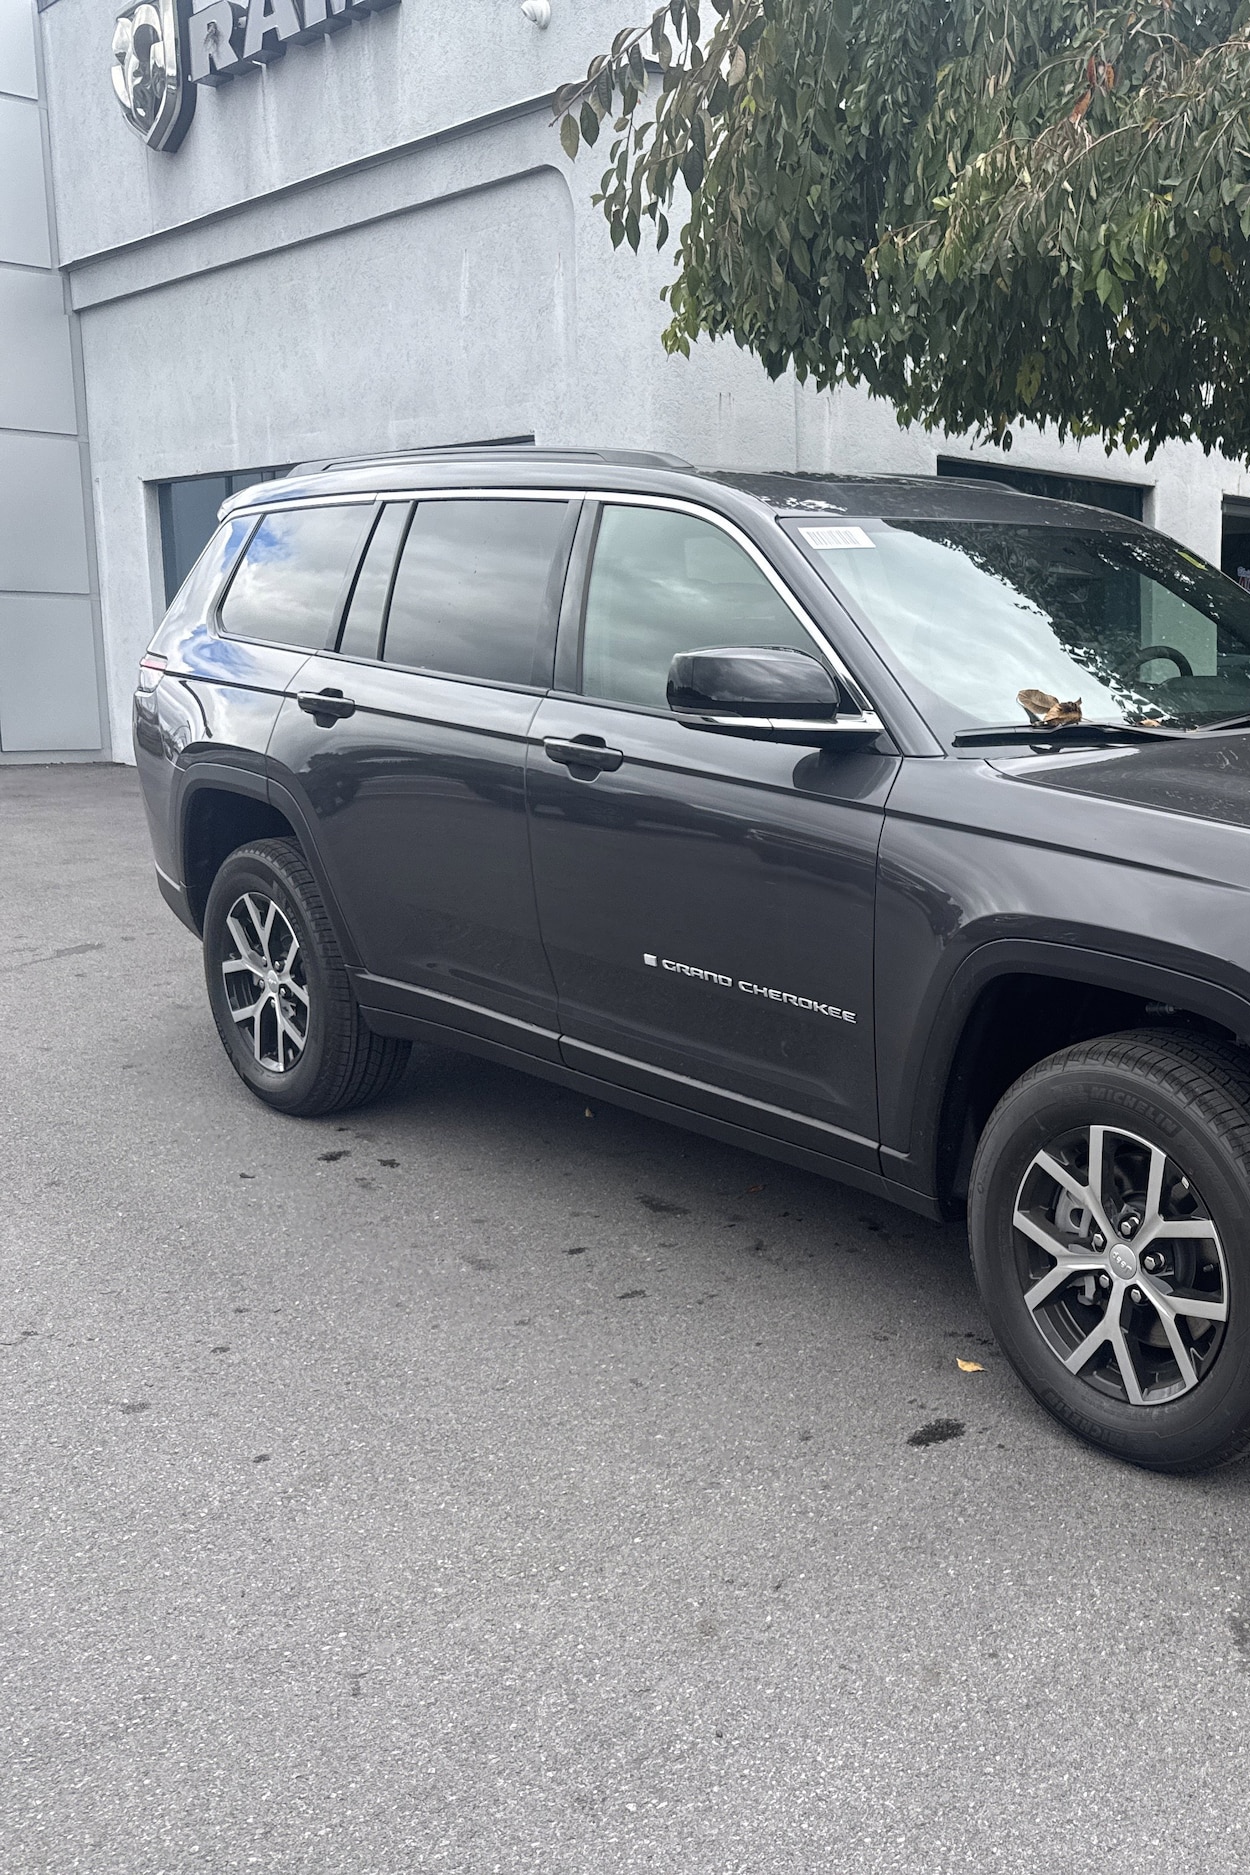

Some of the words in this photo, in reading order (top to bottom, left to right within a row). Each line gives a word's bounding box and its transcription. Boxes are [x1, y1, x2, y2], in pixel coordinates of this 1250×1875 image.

[188, 0, 365, 82] RA
[662, 959, 733, 987] GRAND
[738, 980, 857, 1024] CHEROKEE
[1091, 1086, 1178, 1135] MICHELIN
